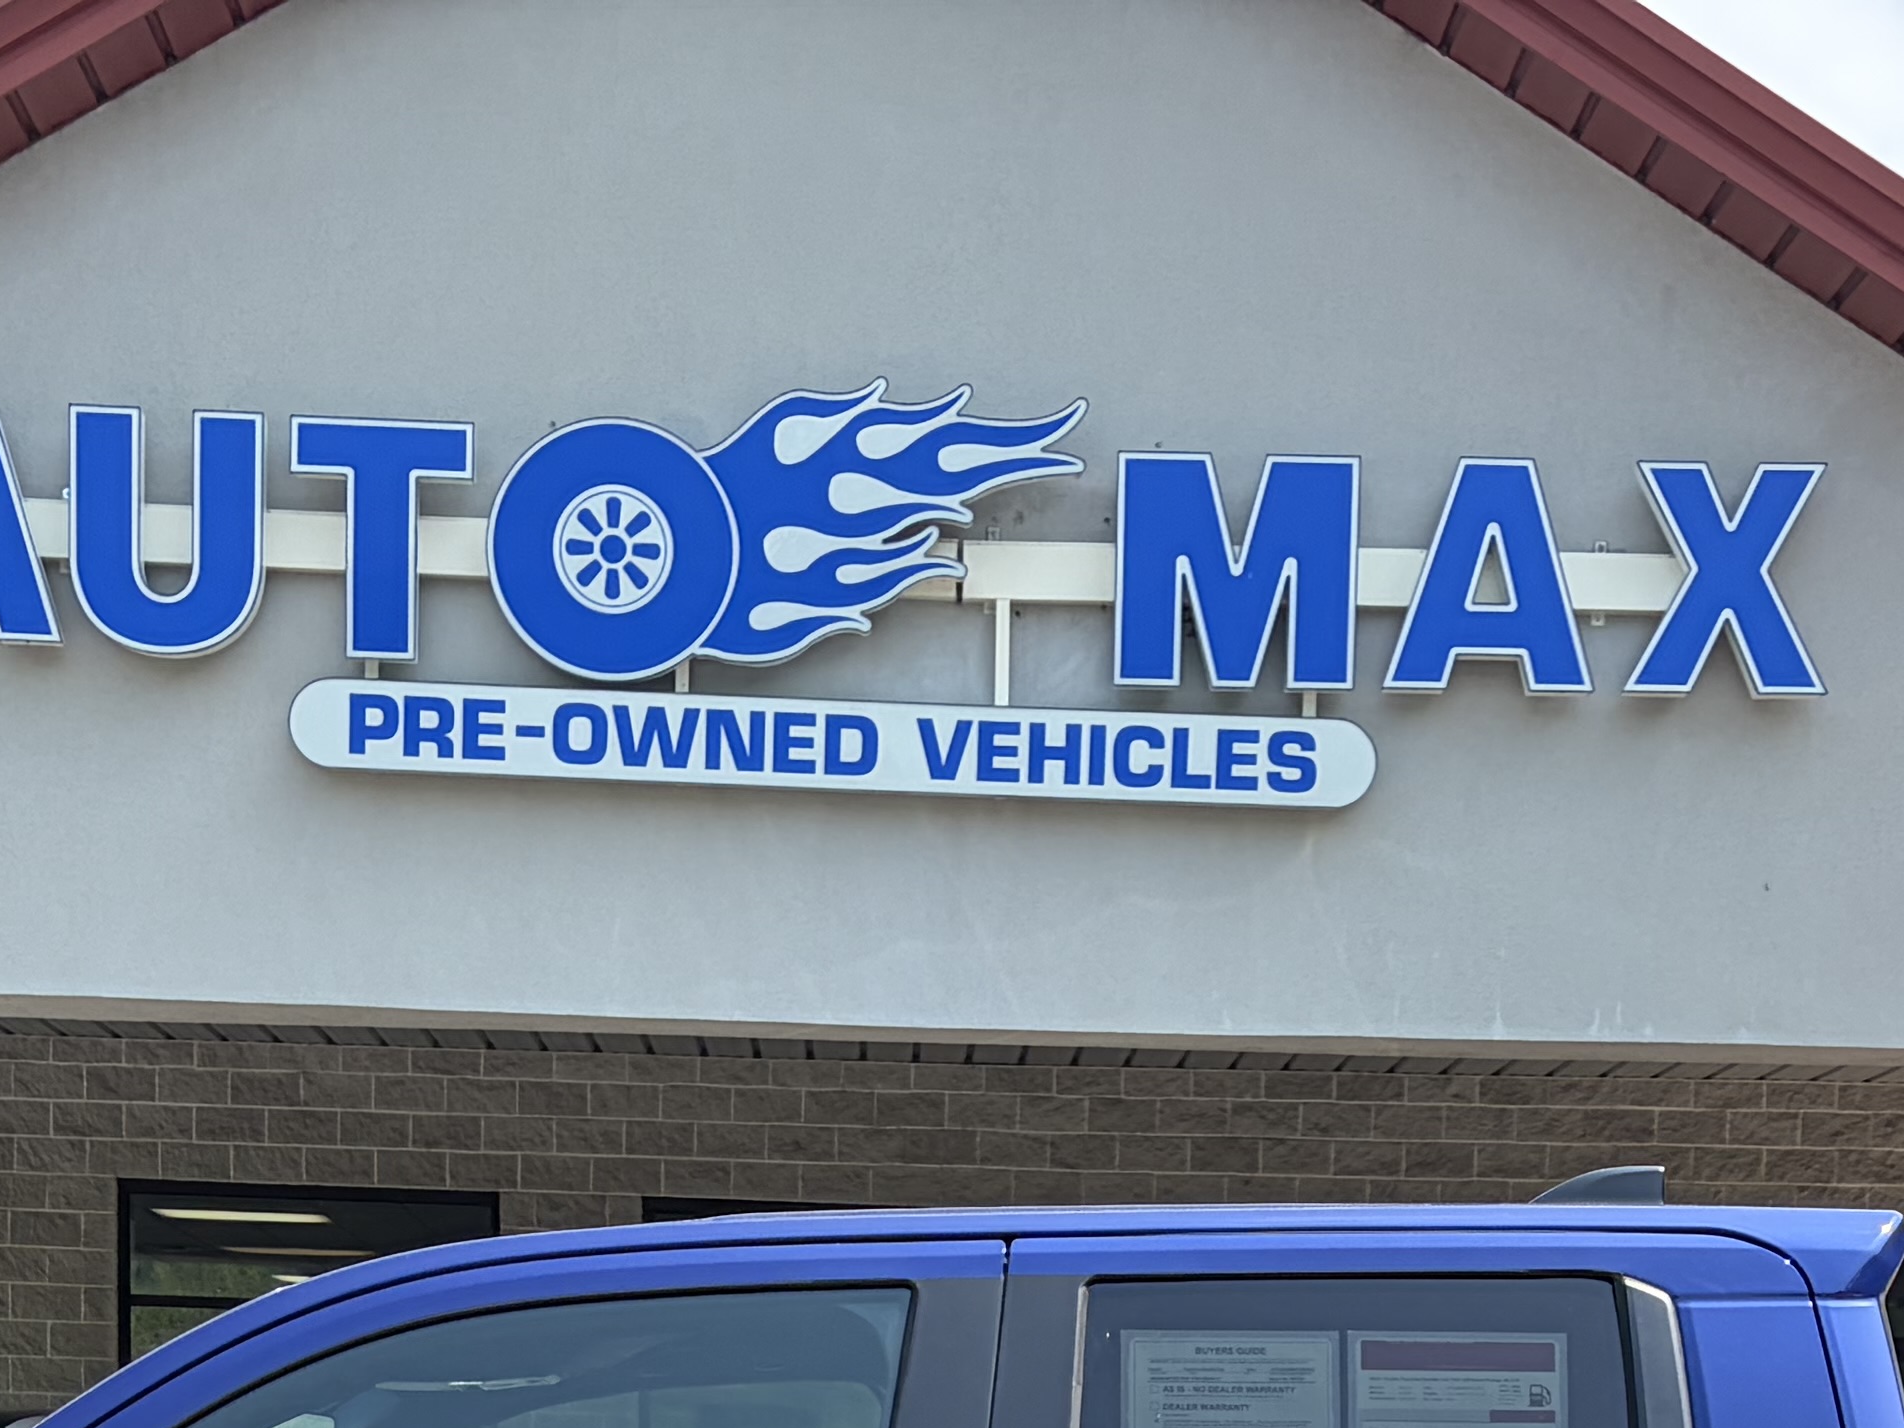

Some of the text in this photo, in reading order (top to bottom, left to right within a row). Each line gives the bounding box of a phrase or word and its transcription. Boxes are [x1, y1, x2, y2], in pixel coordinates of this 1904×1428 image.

[1113, 449, 1829, 701] MAX
[347, 693, 1319, 793] PRE-OWNED VEHICLES
[1194, 1346, 1267, 1356] BUYERS GUIDE
[1208, 1386, 1244, 1394] DEALER
[1245, 1386, 1296, 1395] WARRANTY
[1162, 1403, 1251, 1412] DEALER WARRANTY
